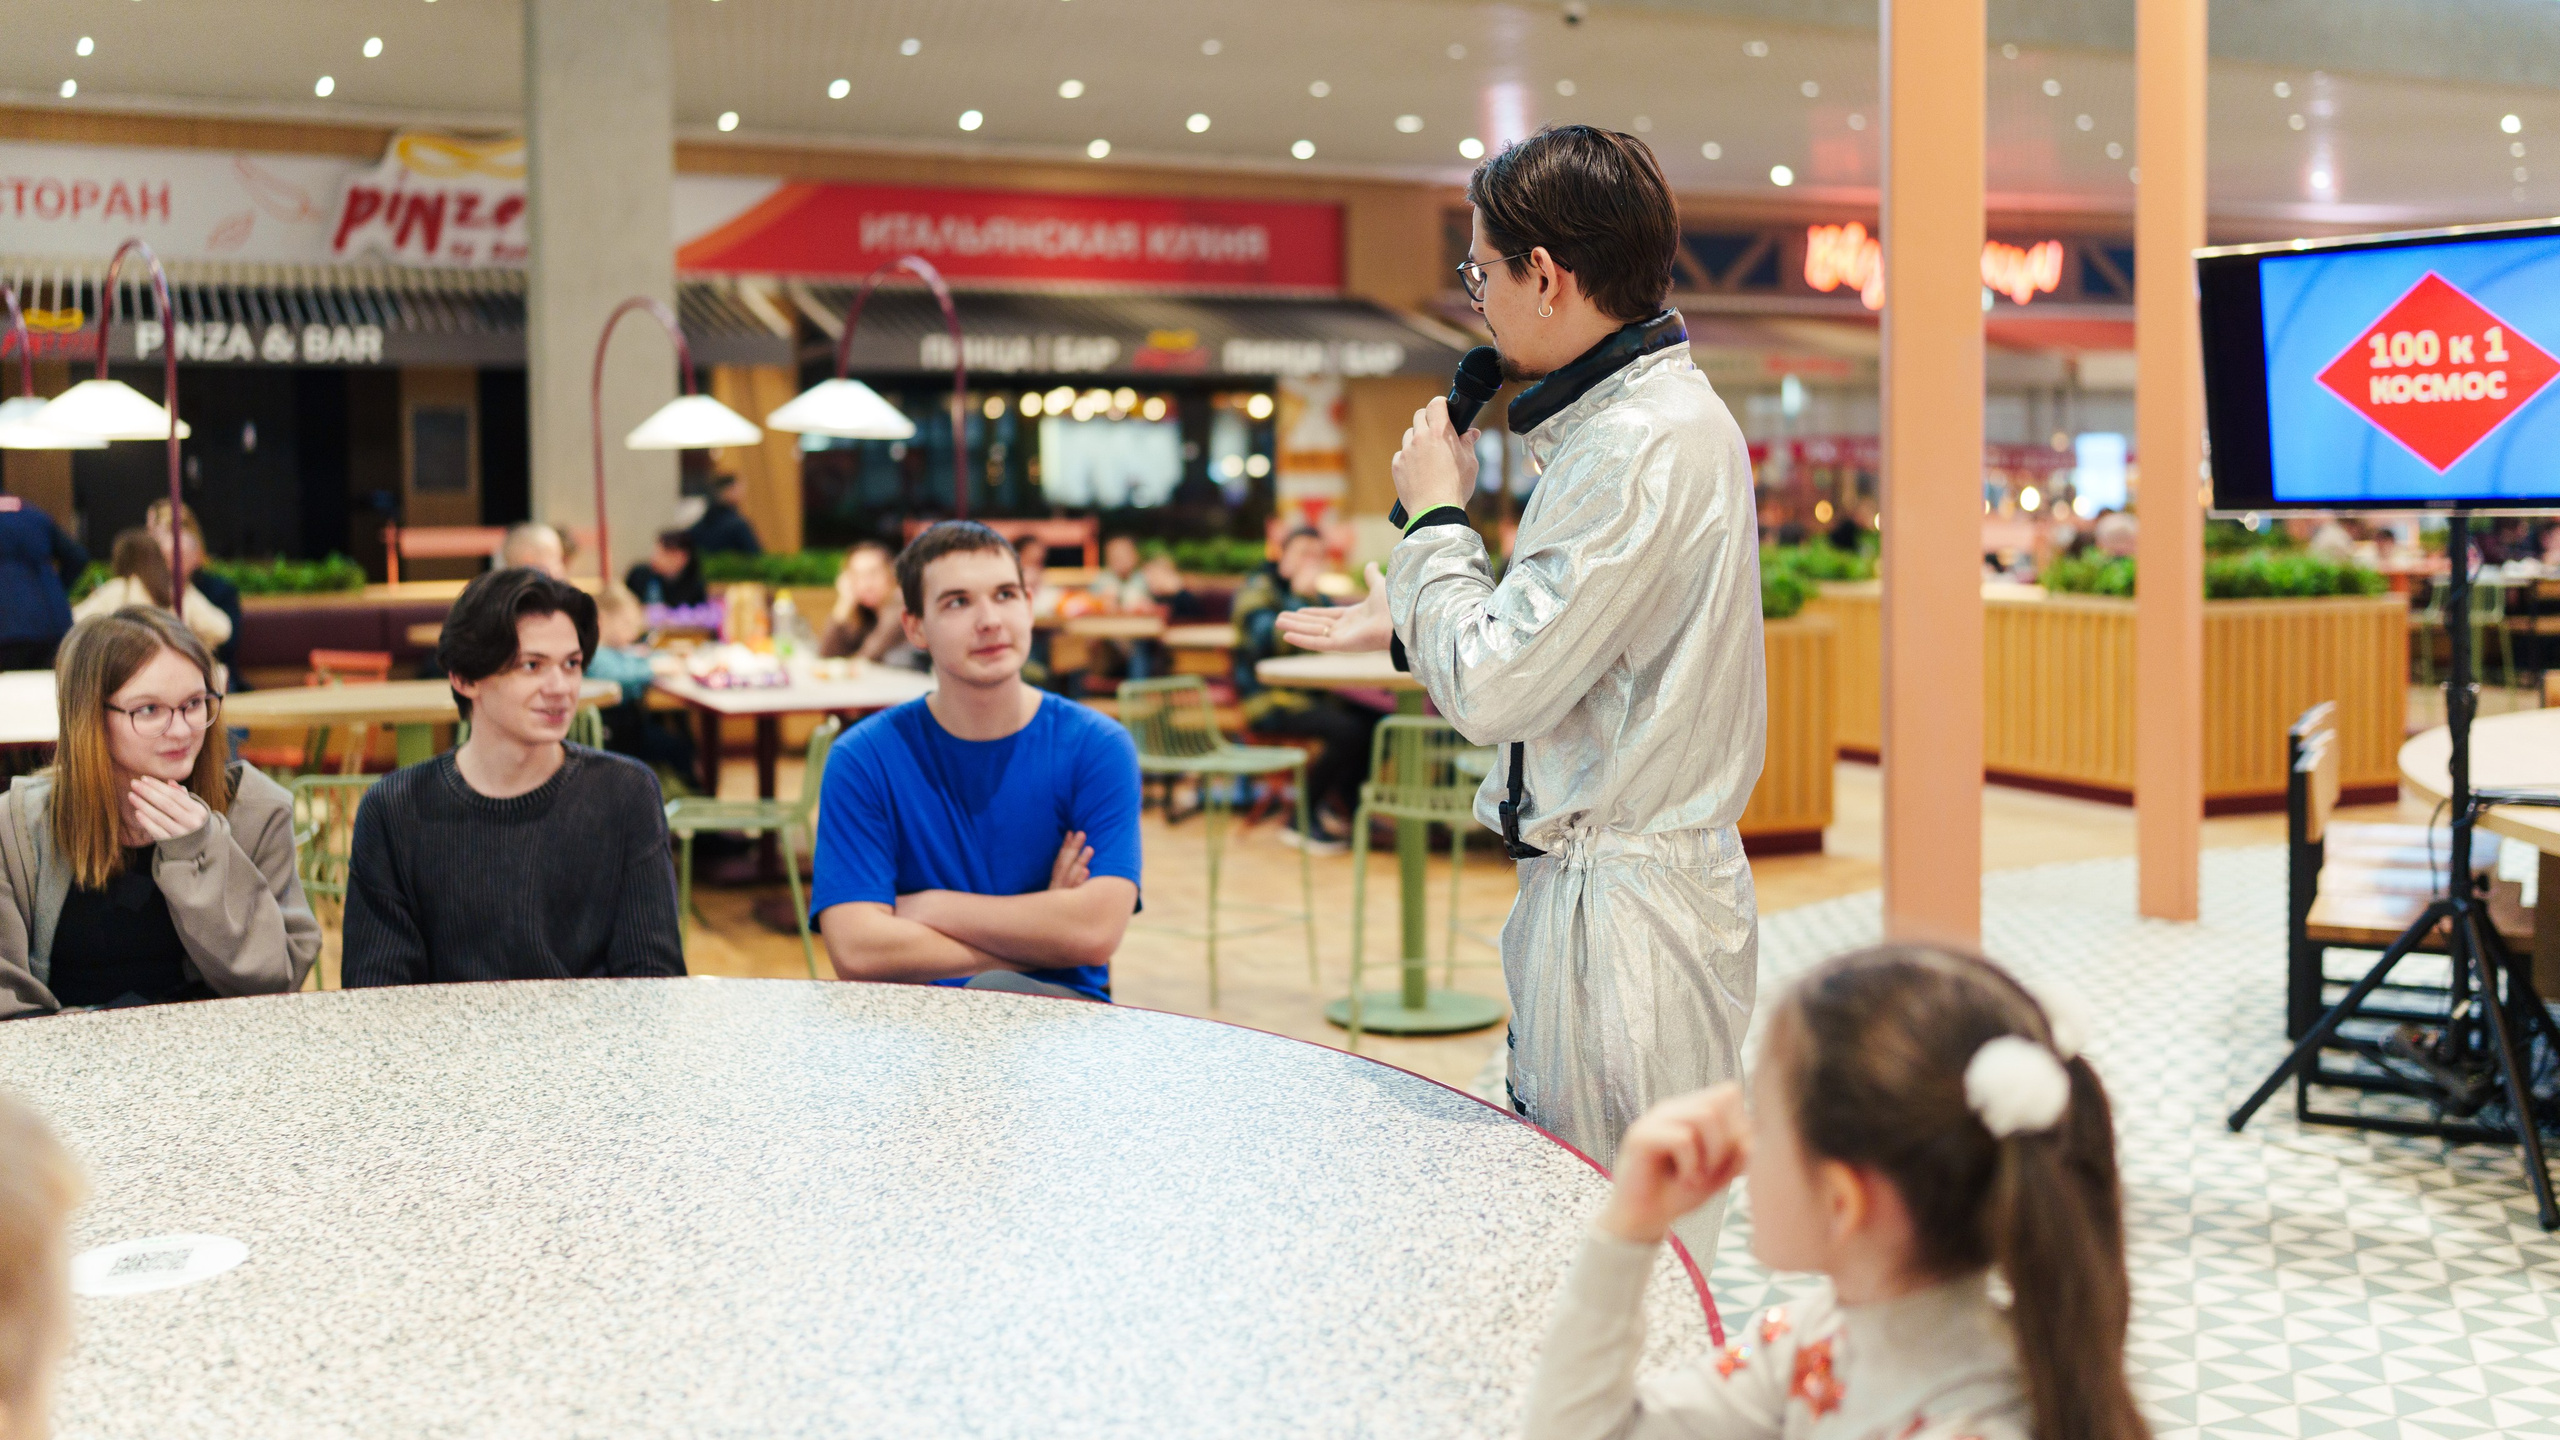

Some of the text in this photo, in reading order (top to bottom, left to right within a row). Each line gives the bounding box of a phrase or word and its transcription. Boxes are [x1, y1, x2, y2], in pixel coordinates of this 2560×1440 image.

[0, 176, 171, 223] ТОРАН
[859, 212, 1268, 263] ИТАЛЬЯНСКАЯ КУХНЯ
[135, 320, 254, 361] PNZA
[262, 323, 296, 363] &
[302, 323, 383, 364] BAR
[2368, 330, 2441, 369] 100
[2483, 326, 2510, 363] 1
[2369, 370, 2508, 405] КОСМОС
